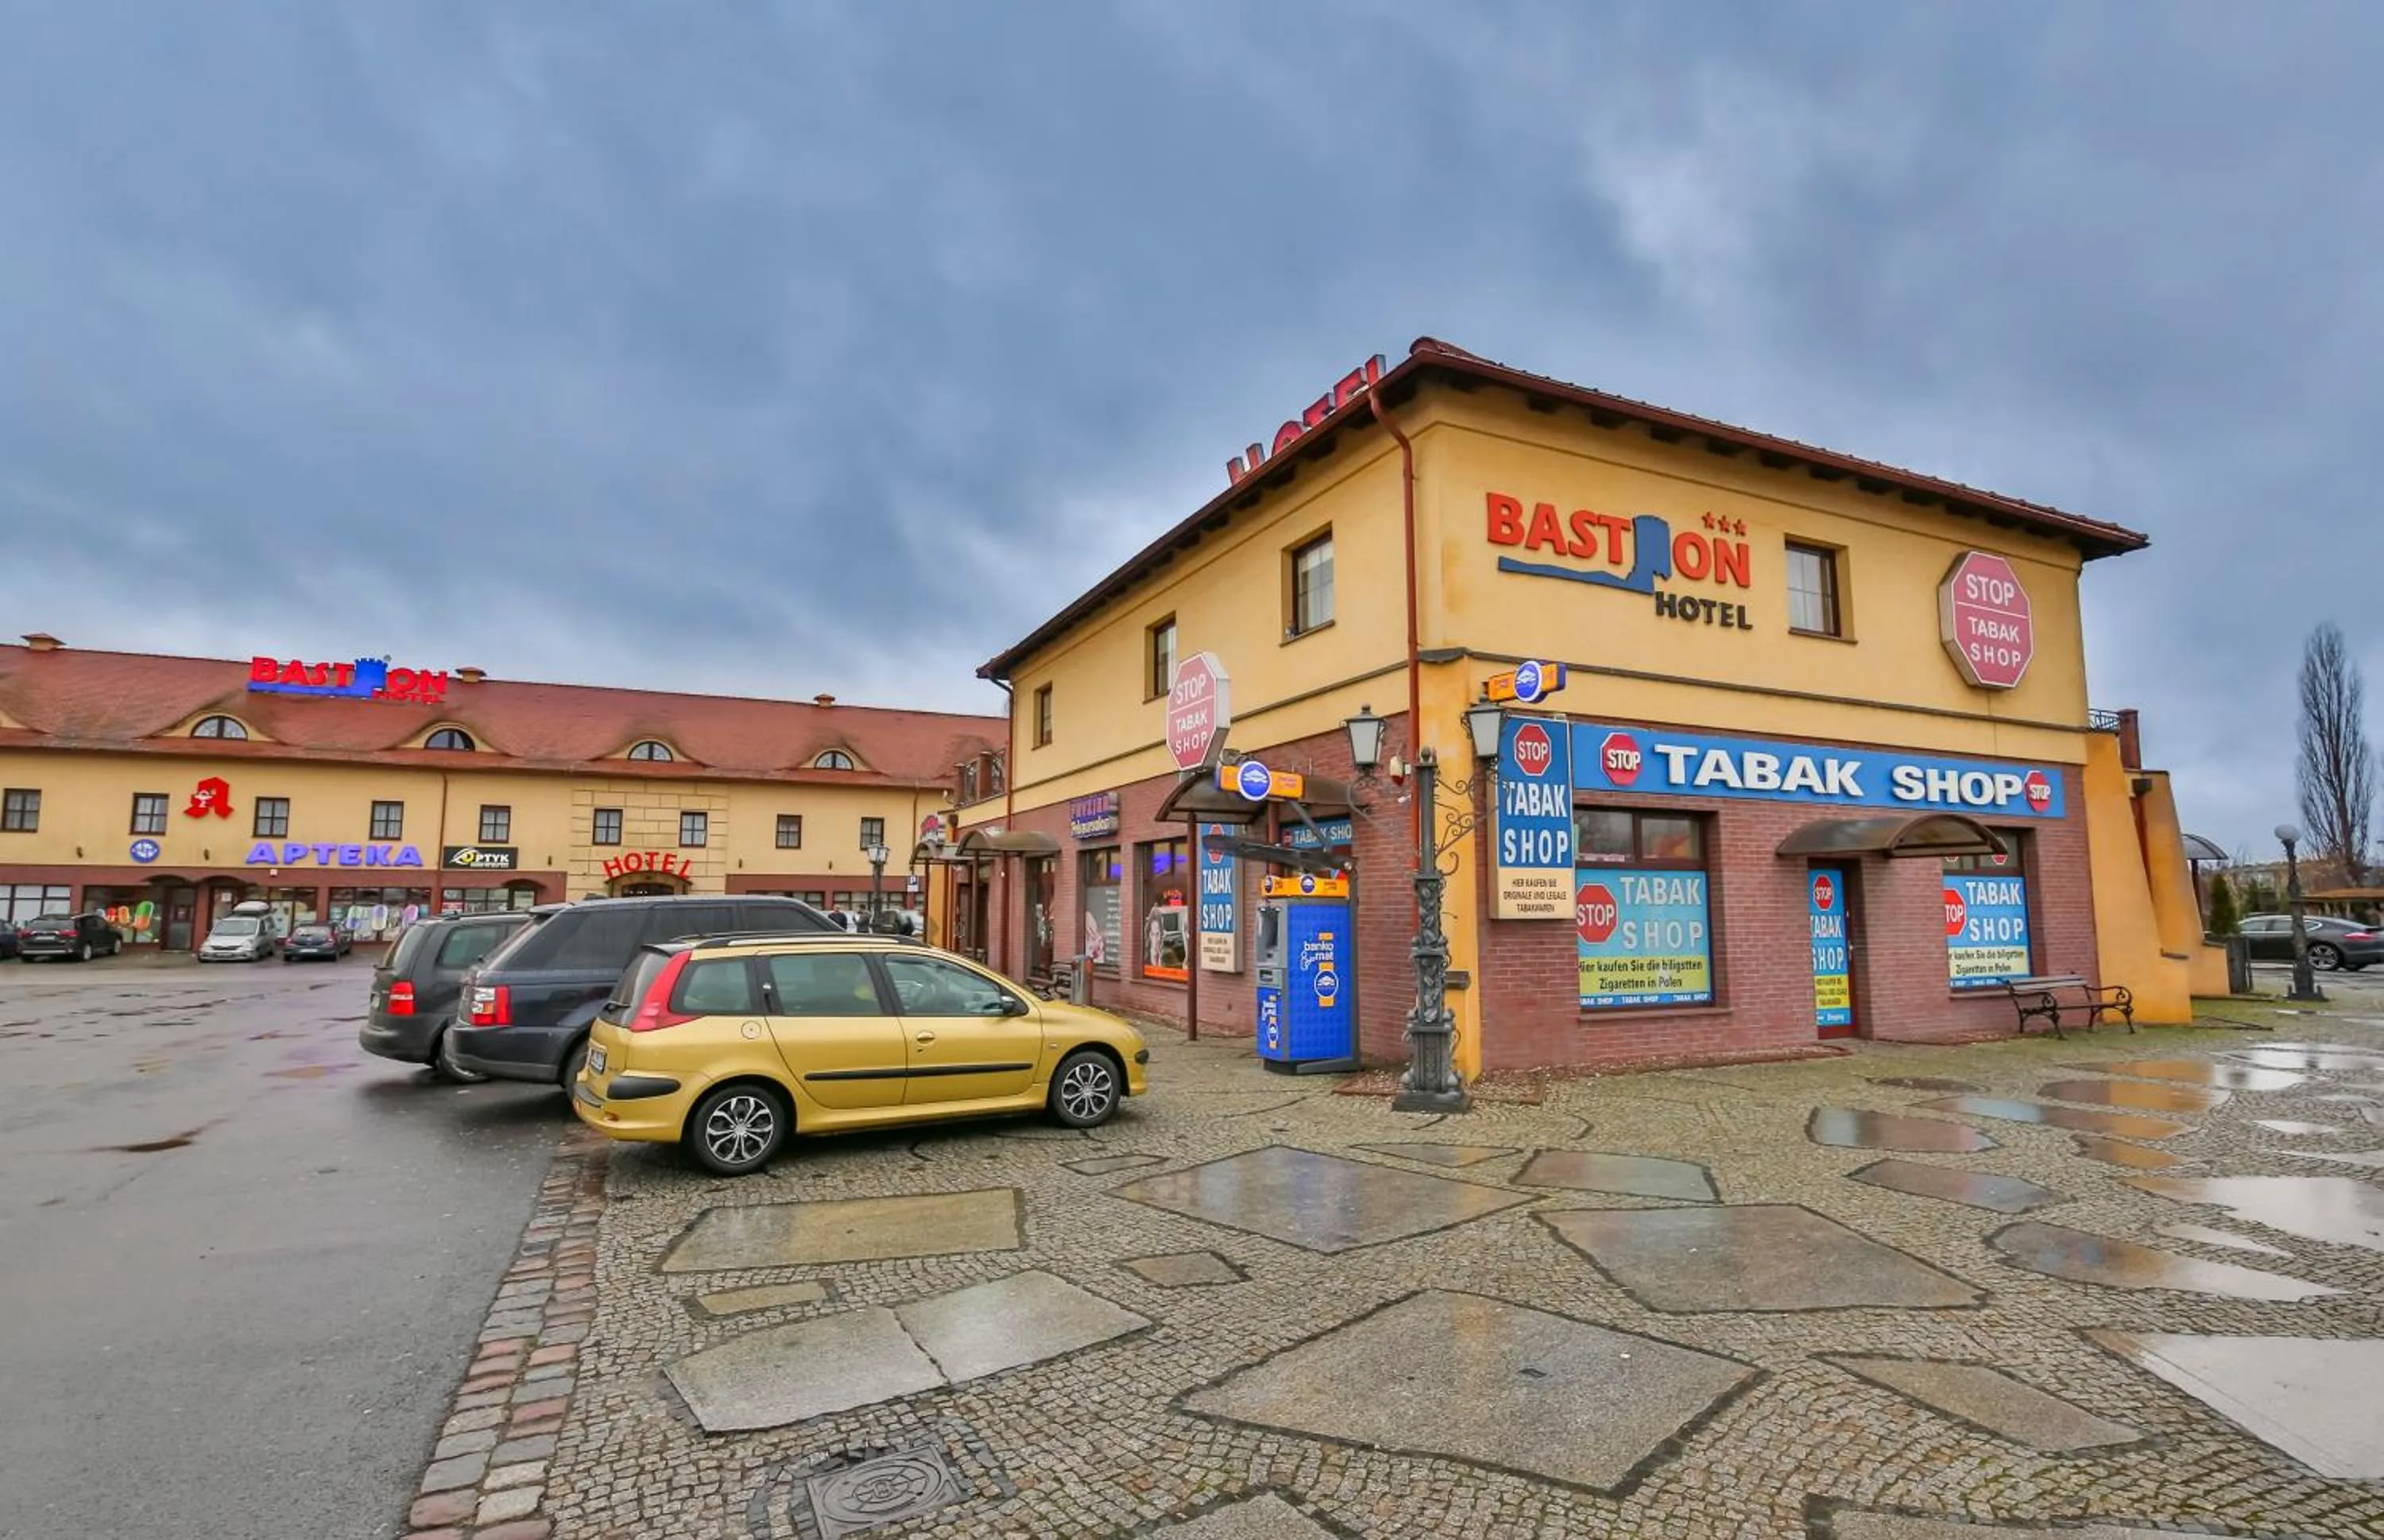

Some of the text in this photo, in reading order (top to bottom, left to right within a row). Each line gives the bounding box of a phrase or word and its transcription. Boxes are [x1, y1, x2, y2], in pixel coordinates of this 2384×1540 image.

[1966, 574, 2014, 606] STOP
[1655, 591, 1753, 630] HOTEL
[1968, 616, 2020, 644] TABAK
[1970, 643, 2021, 668] SHOP
[1176, 673, 1206, 704] STOP
[1175, 706, 1208, 733] TABAK
[1175, 731, 1207, 755] SHOP
[1518, 741, 1548, 761] STOP
[1607, 749, 1641, 771] STOP
[1654, 744, 2022, 805] TABAK SHOP
[1503, 781, 1568, 818] TABAK
[2028, 784, 2051, 801] STOP
[246, 842, 424, 866] APTEKA
[1504, 829, 1569, 865] SHOP
[602, 851, 692, 879] HOTEL
[1202, 868, 1232, 894] TABAK
[1620, 876, 1701, 906] TABAK
[1816, 886, 1832, 900] STOP
[1965, 882, 2022, 905] TABAK
[1202, 903, 1232, 929] SHOP
[1577, 903, 1615, 926] STOP
[1623, 921, 1703, 950] SHOP
[1969, 918, 2023, 941] SHOP
[1597, 960, 1627, 972] kaufen
[1631, 959, 1644, 972] Sie
[1647, 959, 1660, 971] die
[1599, 976, 1682, 992] Zigaretten in Polen
